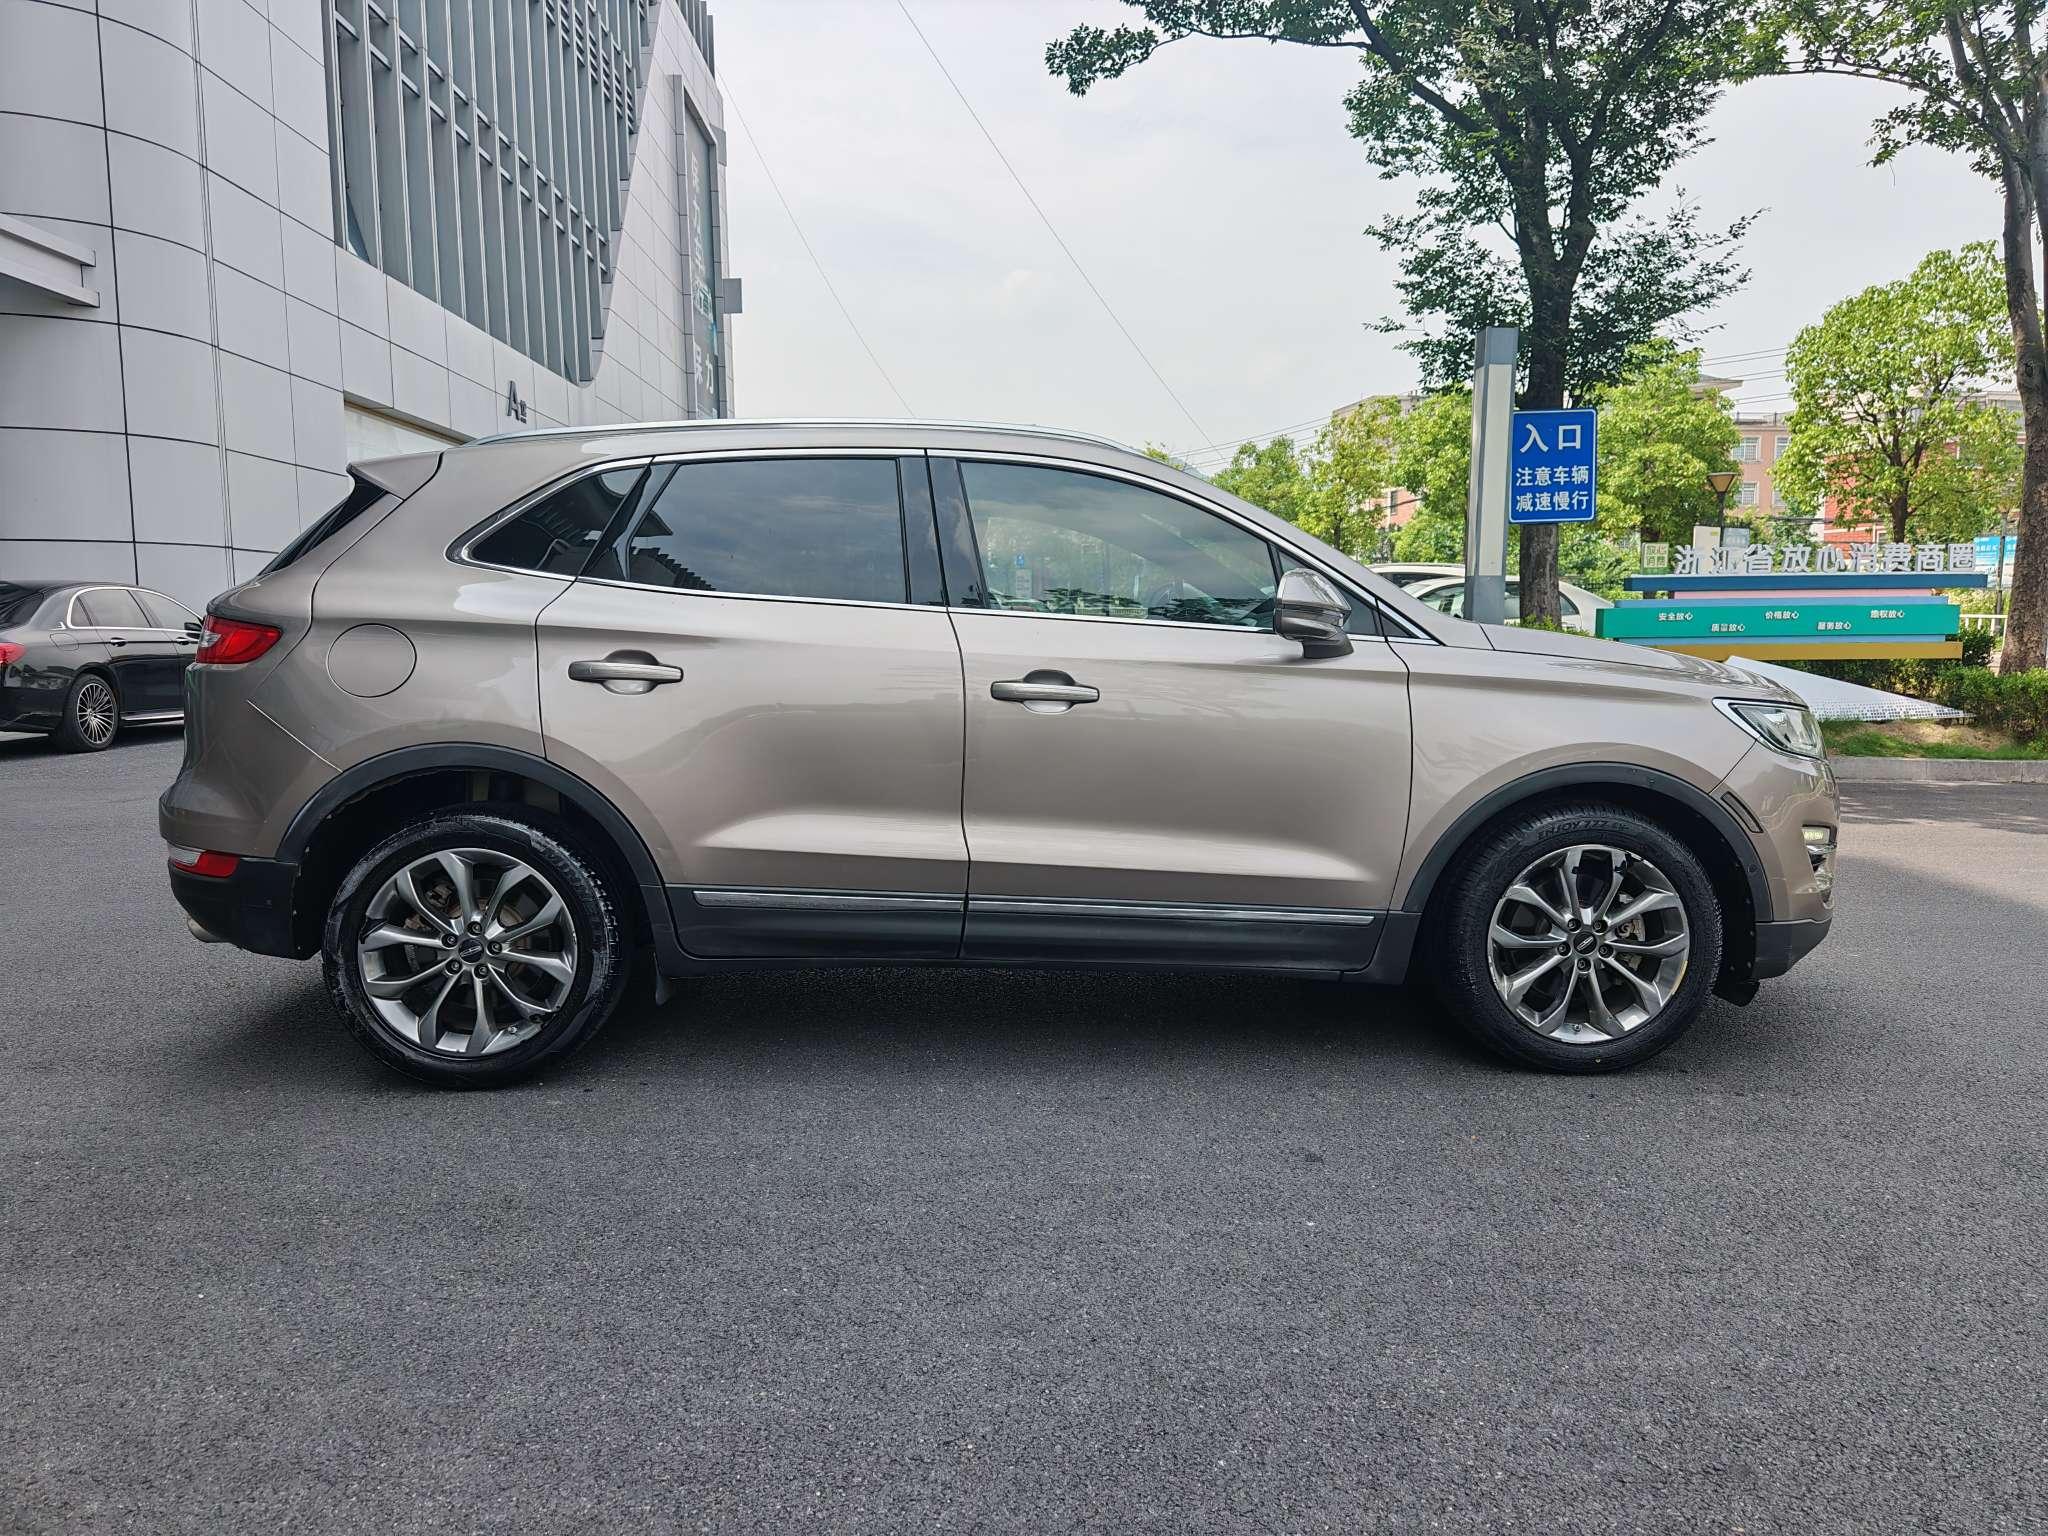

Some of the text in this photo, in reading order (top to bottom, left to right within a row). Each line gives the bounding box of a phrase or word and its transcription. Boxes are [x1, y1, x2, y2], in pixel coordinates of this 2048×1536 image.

[1520, 424, 1581, 453] 入口
[1516, 465, 1589, 486] 注意车辆
[1516, 491, 1589, 512] 减速慢行
[1671, 542, 1975, 574] 浙江省放心消费商圈
[1658, 612, 1693, 621] 安全放心
[1765, 611, 1799, 620] 价格放心
